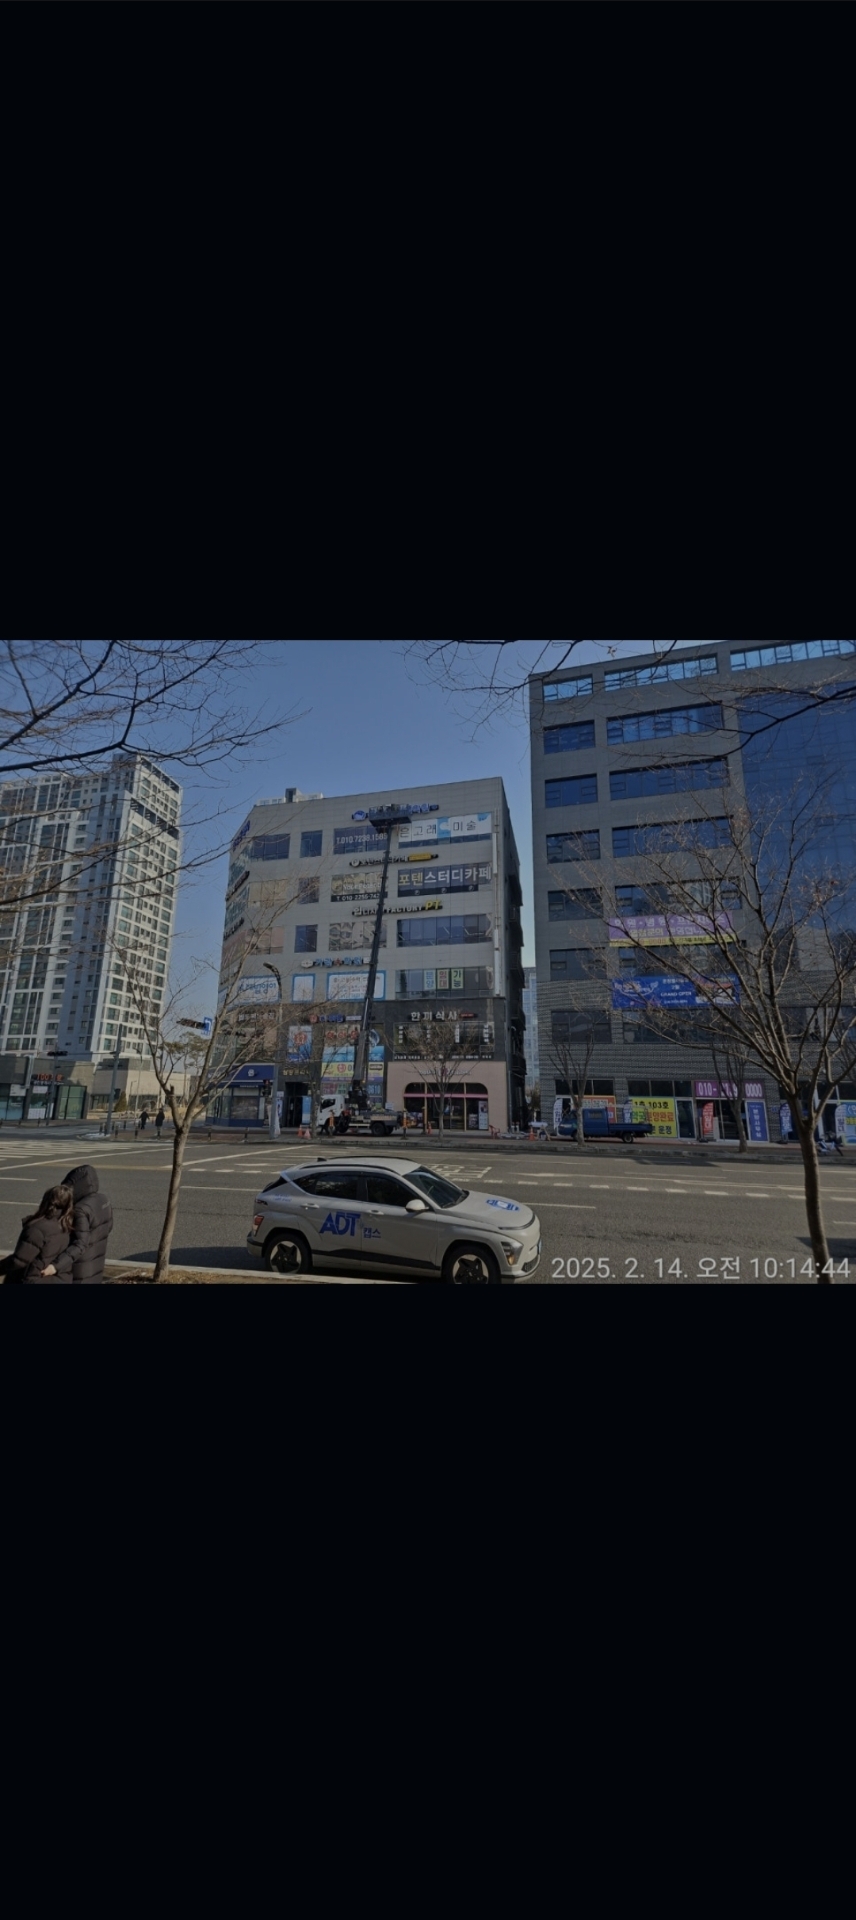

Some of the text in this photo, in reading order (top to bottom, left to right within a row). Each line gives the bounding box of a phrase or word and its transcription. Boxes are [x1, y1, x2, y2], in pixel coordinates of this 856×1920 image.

[399, 866, 492, 886] 포텐스터디카페
[425, 900, 441, 912] PT
[453, 969, 462, 988] 가능
[319, 1211, 361, 1237] ADT
[363, 1227, 382, 1239] 캡스
